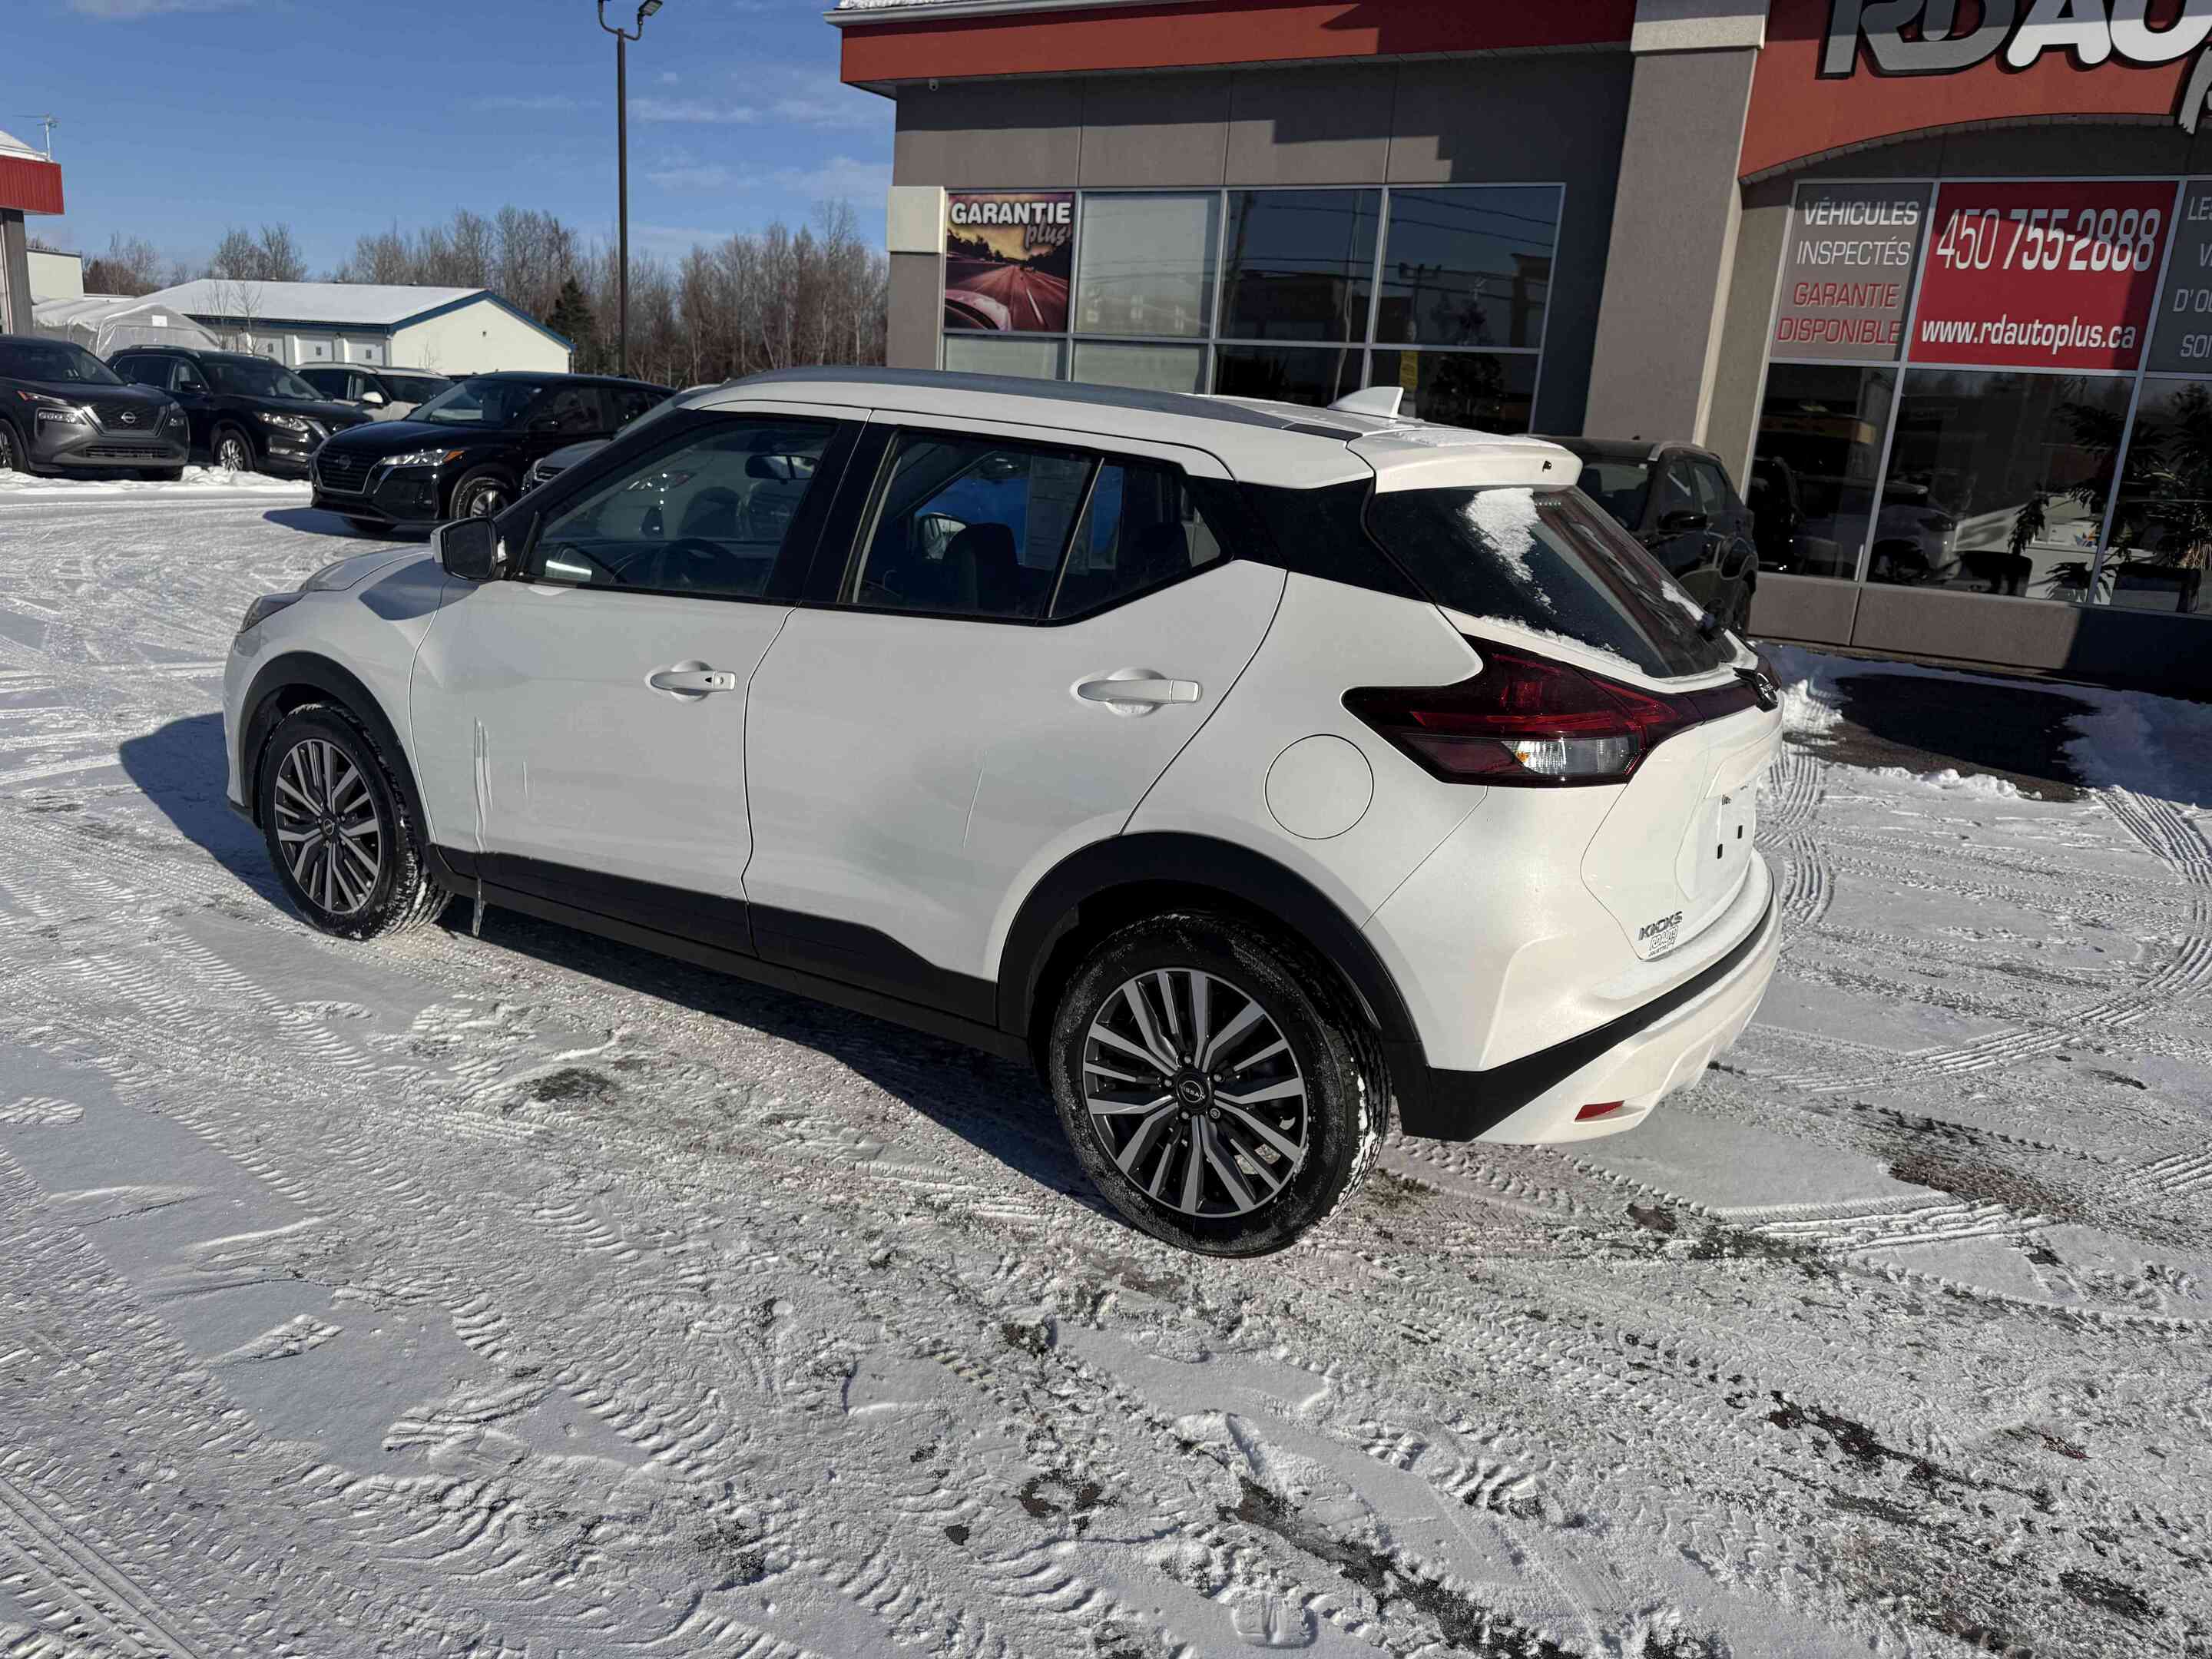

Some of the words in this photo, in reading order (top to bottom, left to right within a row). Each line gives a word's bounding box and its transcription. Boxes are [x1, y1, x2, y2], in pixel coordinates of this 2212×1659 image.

[951, 202, 1071, 224] GARANTIE
[1805, 197, 1919, 226] VÉHICULES
[2187, 197, 2212, 221] LE
[1025, 221, 1066, 248] plus
[1936, 208, 2000, 270] 450
[2002, 208, 2161, 271] 755-2888
[1796, 236, 1912, 266] INSPECTÉS
[1794, 282, 1901, 309] GARANTIE
[1777, 318, 1902, 346] DISPONIBLE
[1922, 314, 2137, 356] www.rdautoplus.ca
[1637, 911, 1683, 941] KICKS
